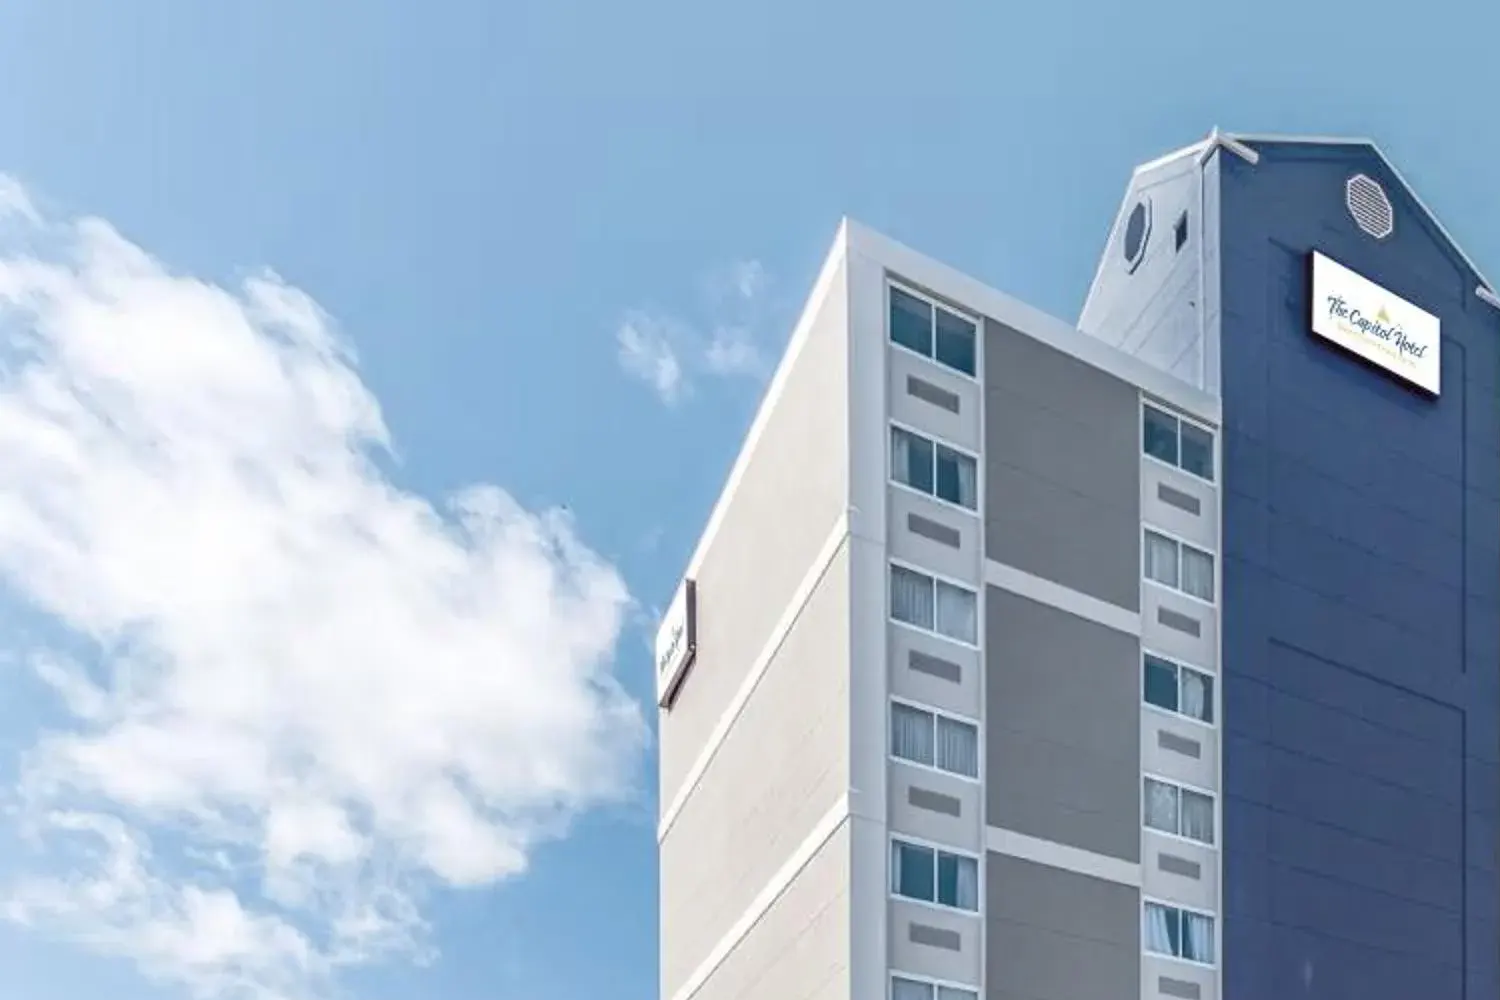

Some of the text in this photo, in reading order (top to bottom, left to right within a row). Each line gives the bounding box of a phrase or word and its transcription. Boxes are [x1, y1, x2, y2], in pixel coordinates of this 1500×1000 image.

[1327, 295, 1349, 319] The
[1350, 309, 1395, 341] Capitol
[1393, 325, 1429, 358] Hotel
